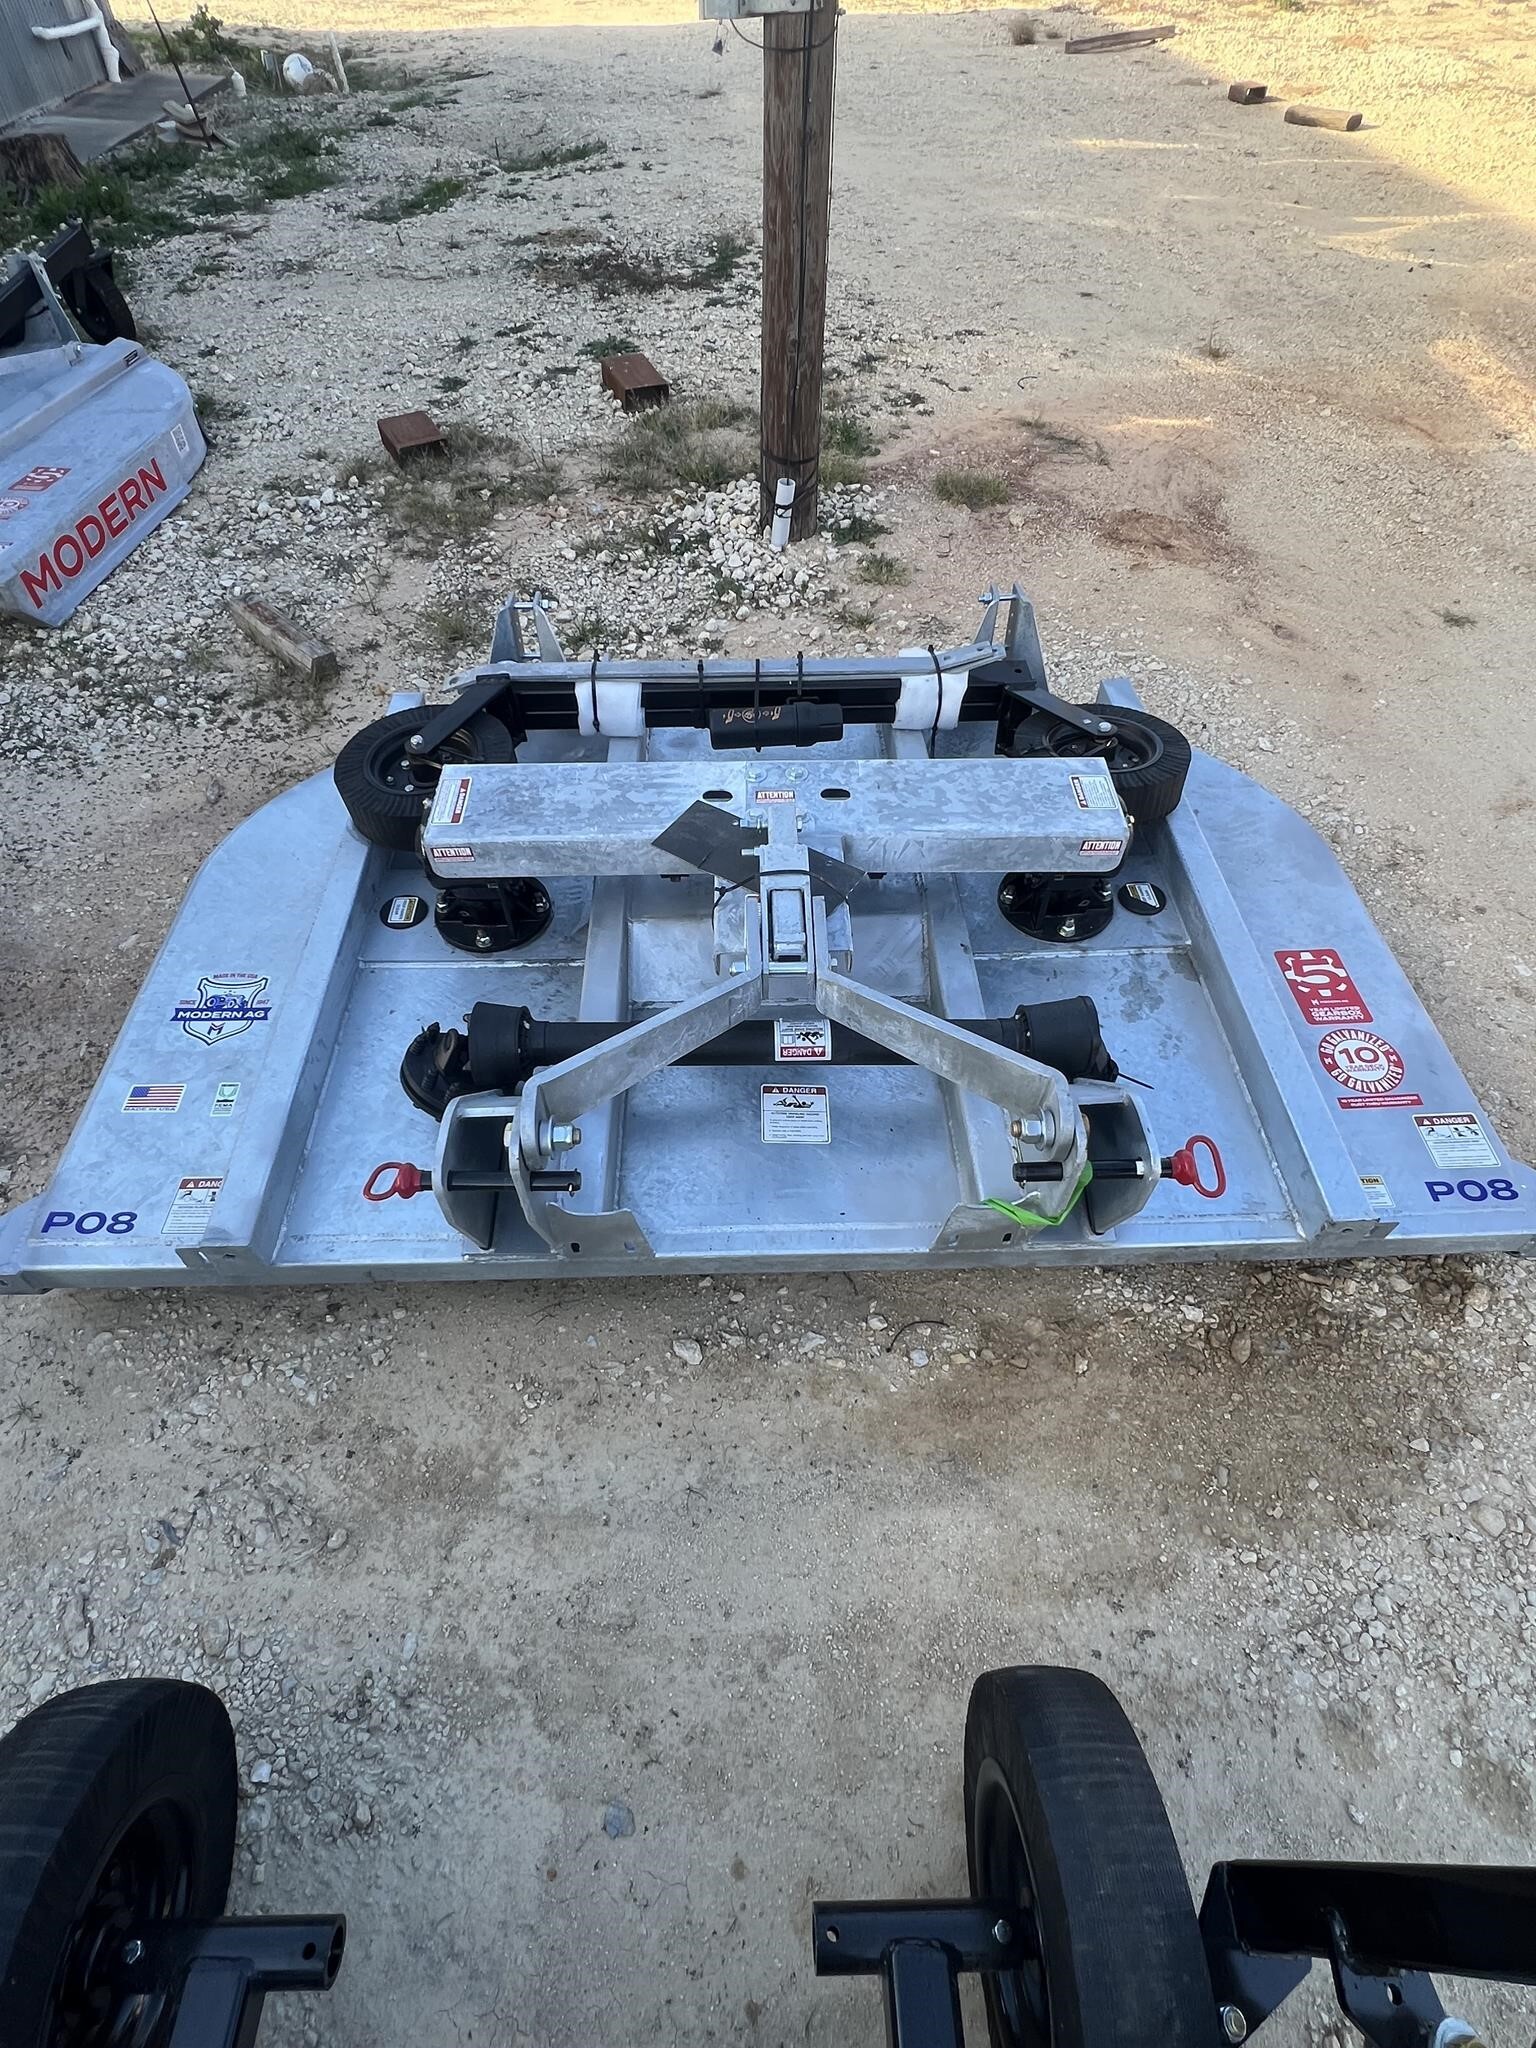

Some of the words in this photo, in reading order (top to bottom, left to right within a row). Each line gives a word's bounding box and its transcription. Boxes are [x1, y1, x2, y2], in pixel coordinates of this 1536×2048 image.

[19, 457, 168, 609] MODERN
[757, 791, 794, 799] ATTENTION
[454, 791, 467, 814] DANGER
[1081, 841, 1122, 850] ATTENTION
[432, 847, 472, 857] ATTENTION
[177, 1010, 242, 1019] MODERN
[243, 1010, 266, 1018] AG
[1313, 1013, 1364, 1021] WARRANTY
[1326, 1030, 1390, 1052] GALVANIZED
[782, 1048, 813, 1057] DANGER
[1320, 1042, 1335, 1054] GO
[1338, 1046, 1380, 1064] 10
[1330, 1068, 1348, 1082] GO
[1347, 1066, 1403, 1093] GALVANIZED
[1432, 1116, 1472, 1125] DANGER
